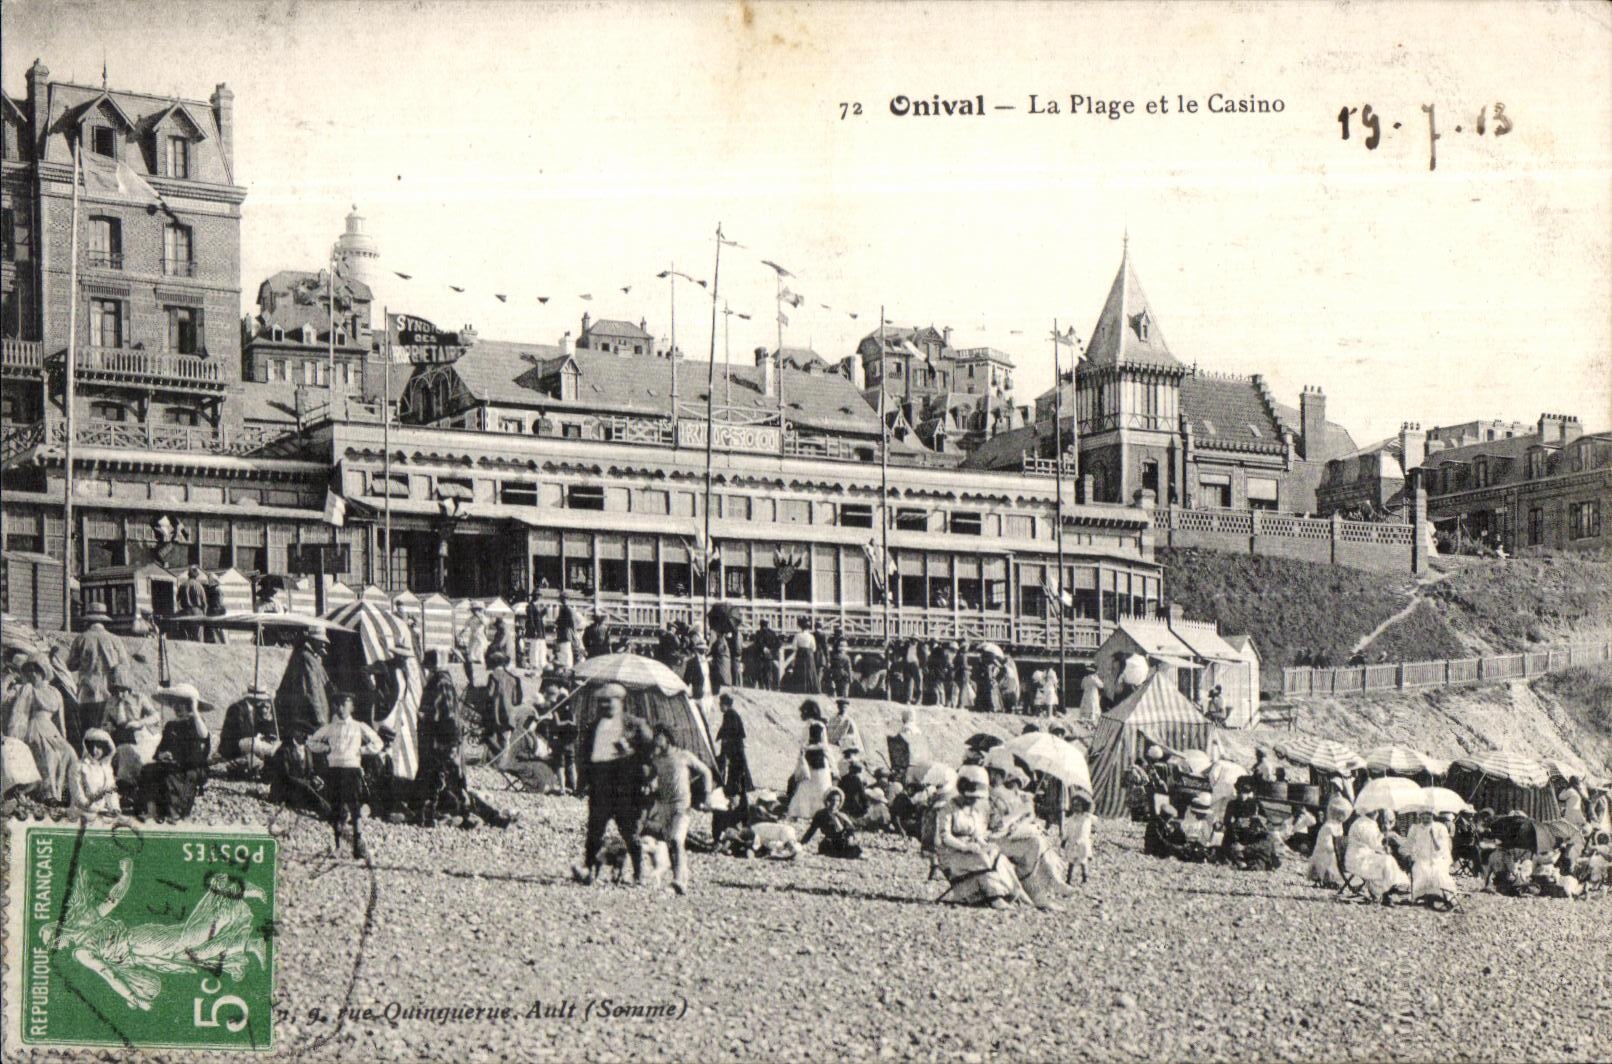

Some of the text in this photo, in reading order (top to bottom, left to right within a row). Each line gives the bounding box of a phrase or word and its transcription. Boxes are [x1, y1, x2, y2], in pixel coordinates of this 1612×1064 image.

[182, 842, 264, 864] POSTES
[30, 837, 53, 1036] REPUBLIQUE FRANÇAISE
